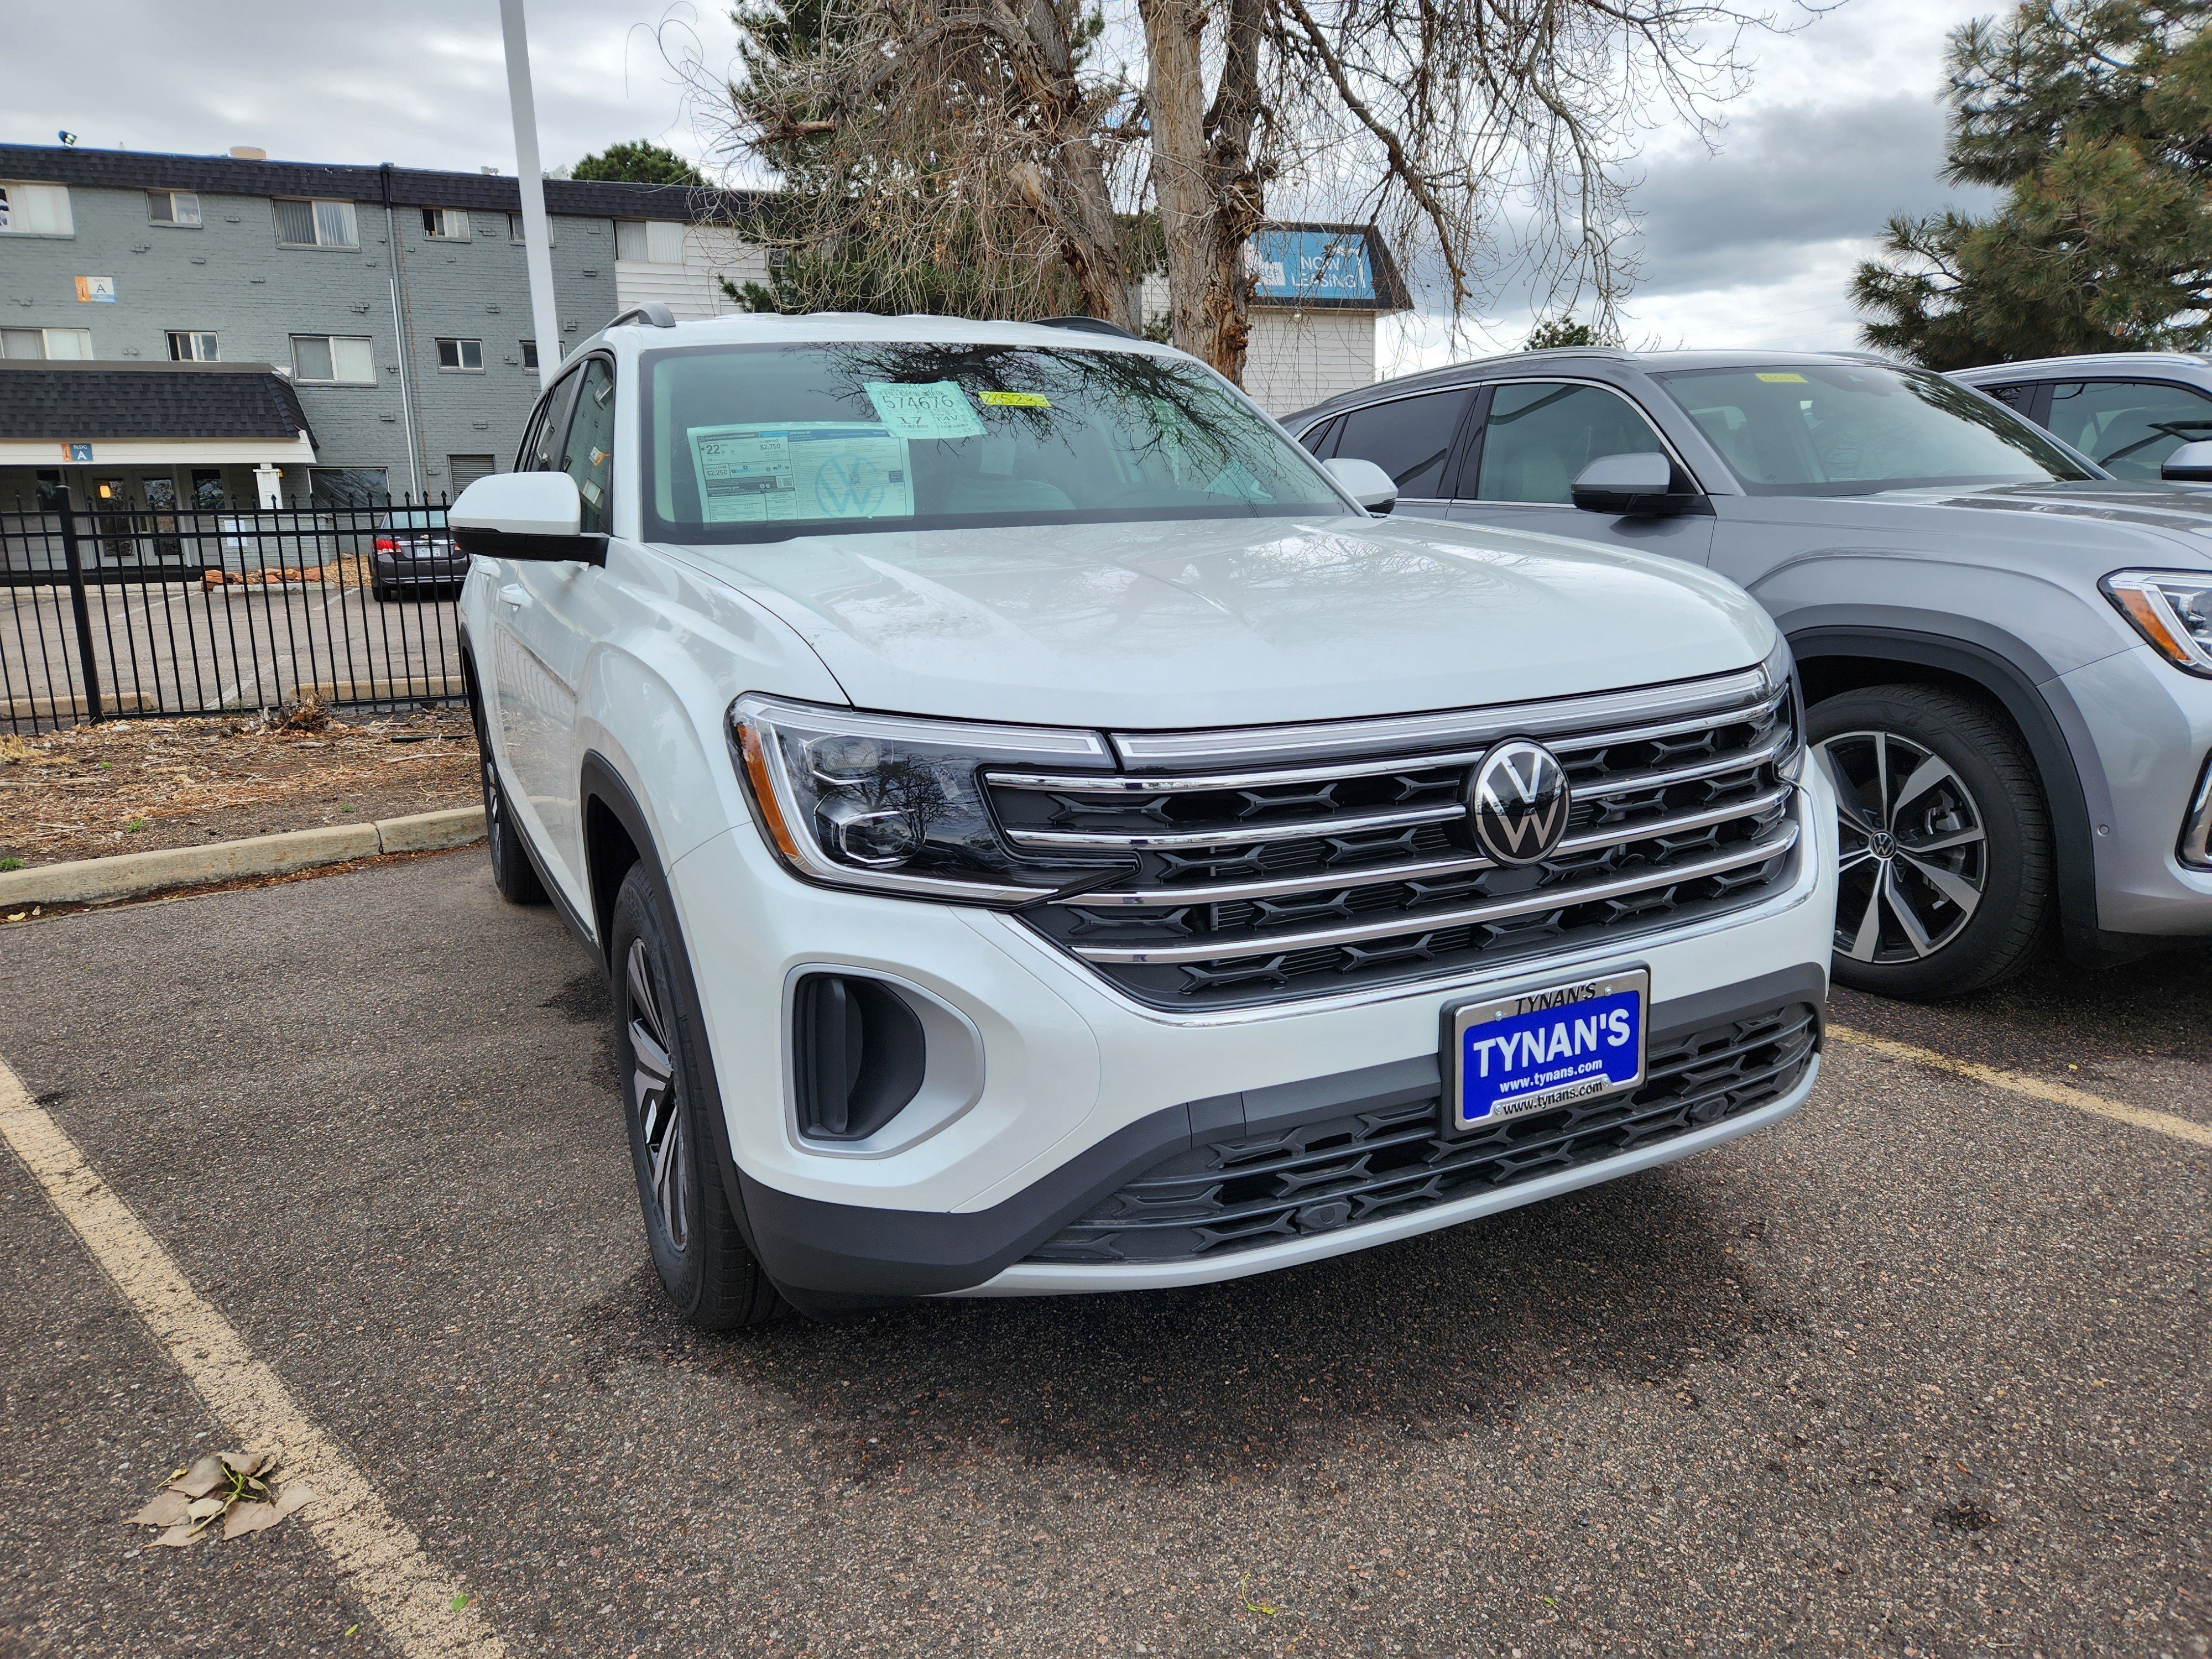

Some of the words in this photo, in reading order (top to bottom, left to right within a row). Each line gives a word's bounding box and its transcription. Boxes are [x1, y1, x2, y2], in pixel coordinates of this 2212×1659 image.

[1300, 257, 1339, 270] NOW
[97, 283, 107, 293] A
[883, 395, 953, 409] 574676
[77, 451, 87, 460] A
[706, 444, 721, 455] 22
[1515, 983, 1596, 1016] TYNAN'S
[1473, 1008, 1631, 1078] TYNAN'S
[1499, 1059, 1603, 1093] www.tynans.com
[1503, 1080, 1603, 1115] www.tynans.com
